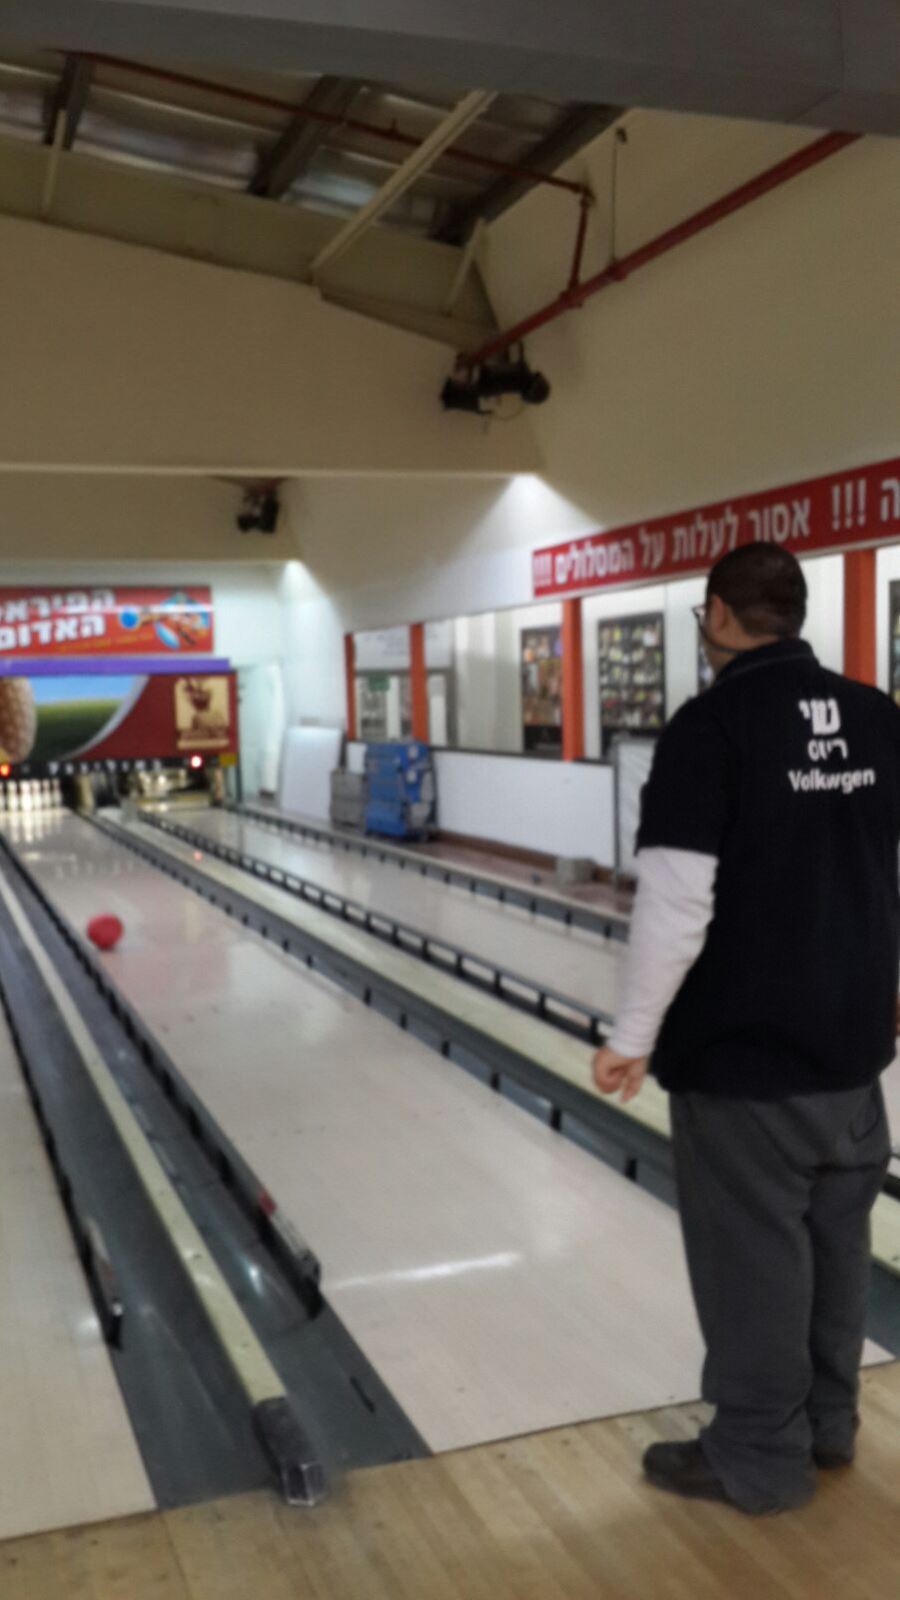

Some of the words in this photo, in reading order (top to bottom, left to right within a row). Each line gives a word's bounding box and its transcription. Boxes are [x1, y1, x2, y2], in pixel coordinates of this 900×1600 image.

[747, 496, 811, 543] אסור
[831, 479, 867, 531] !!!
[638, 526, 666, 571] על
[672, 504, 739, 563] לעלות
[554, 538, 635, 585] המסלולים
[0, 589, 115, 624] הפירא
[0, 614, 105, 650] האדום
[798, 697, 841, 736] שי
[788, 768, 876, 794] Volkwgen
